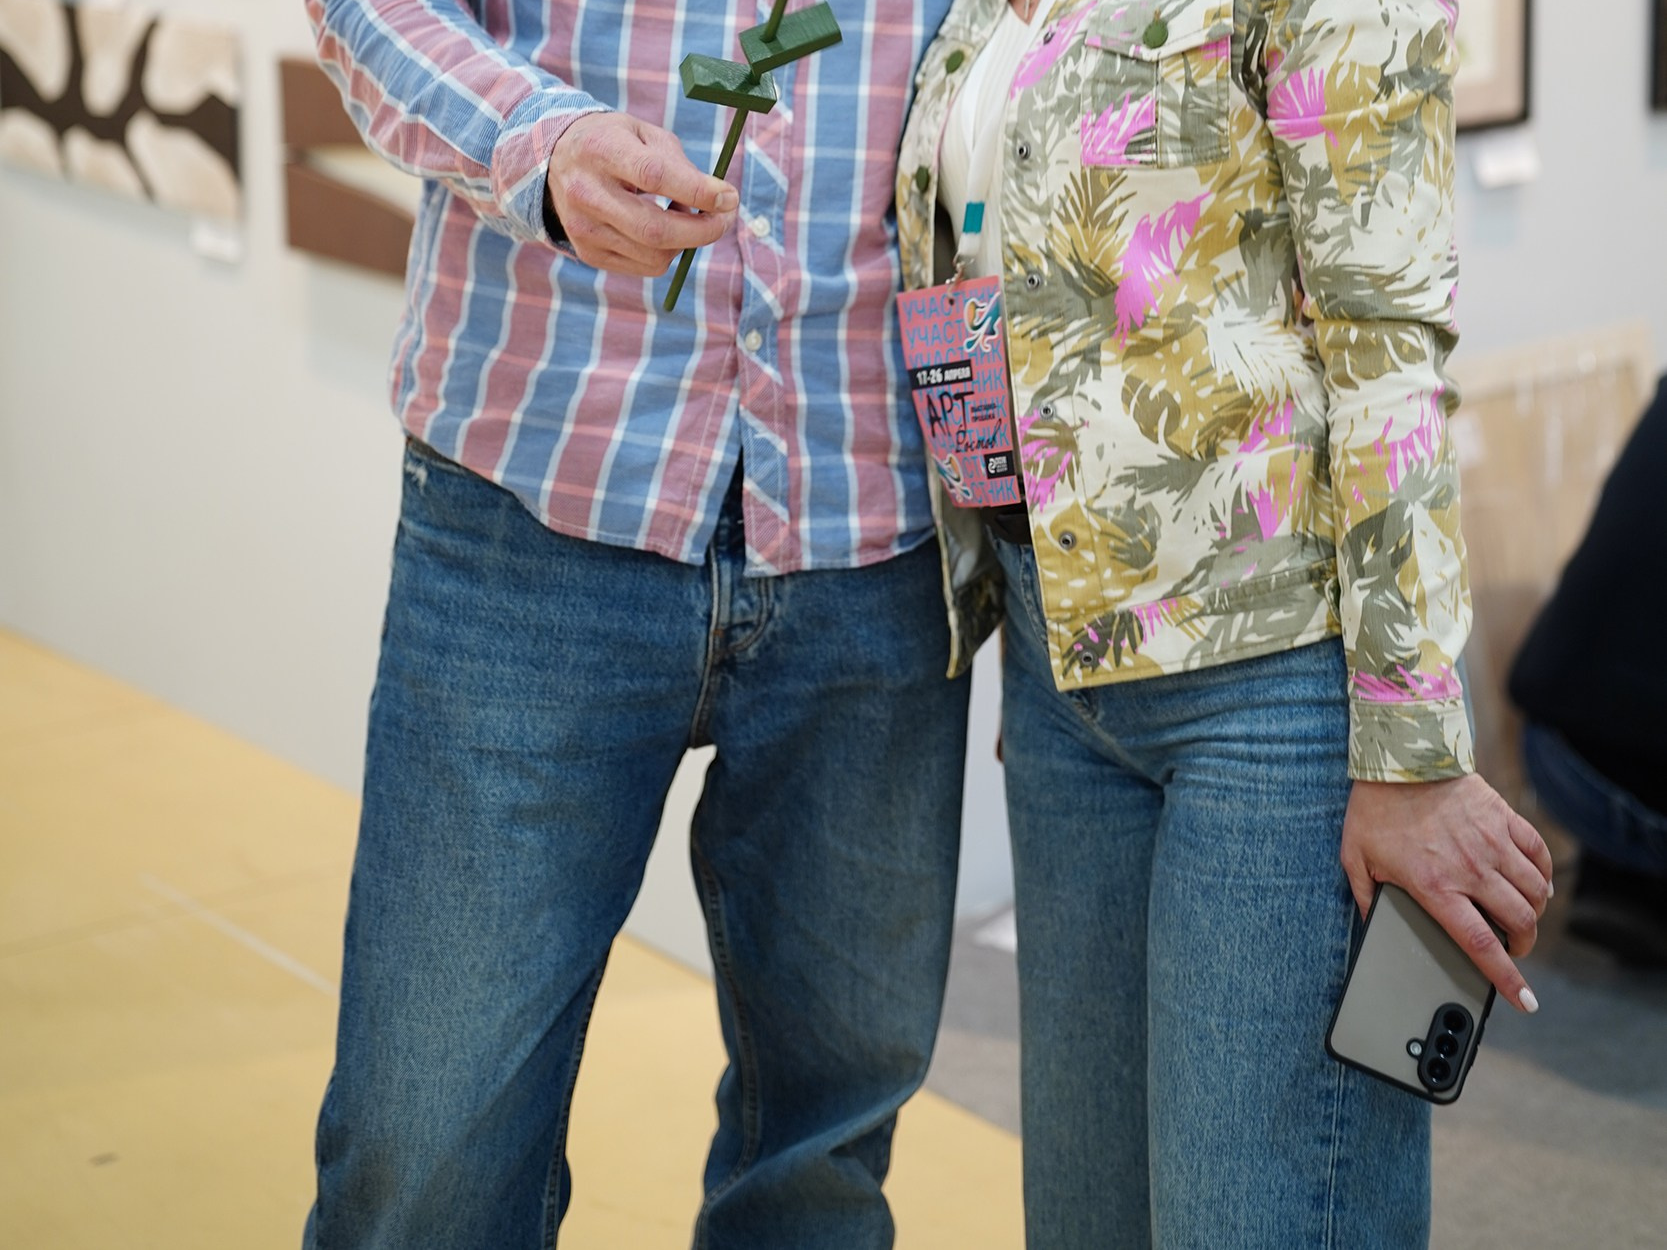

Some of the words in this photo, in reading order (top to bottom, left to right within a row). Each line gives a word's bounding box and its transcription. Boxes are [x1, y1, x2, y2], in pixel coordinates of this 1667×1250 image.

[905, 319, 968, 349] УЧАСТ
[916, 368, 943, 386] 17-26
[926, 391, 974, 438] АРТ
